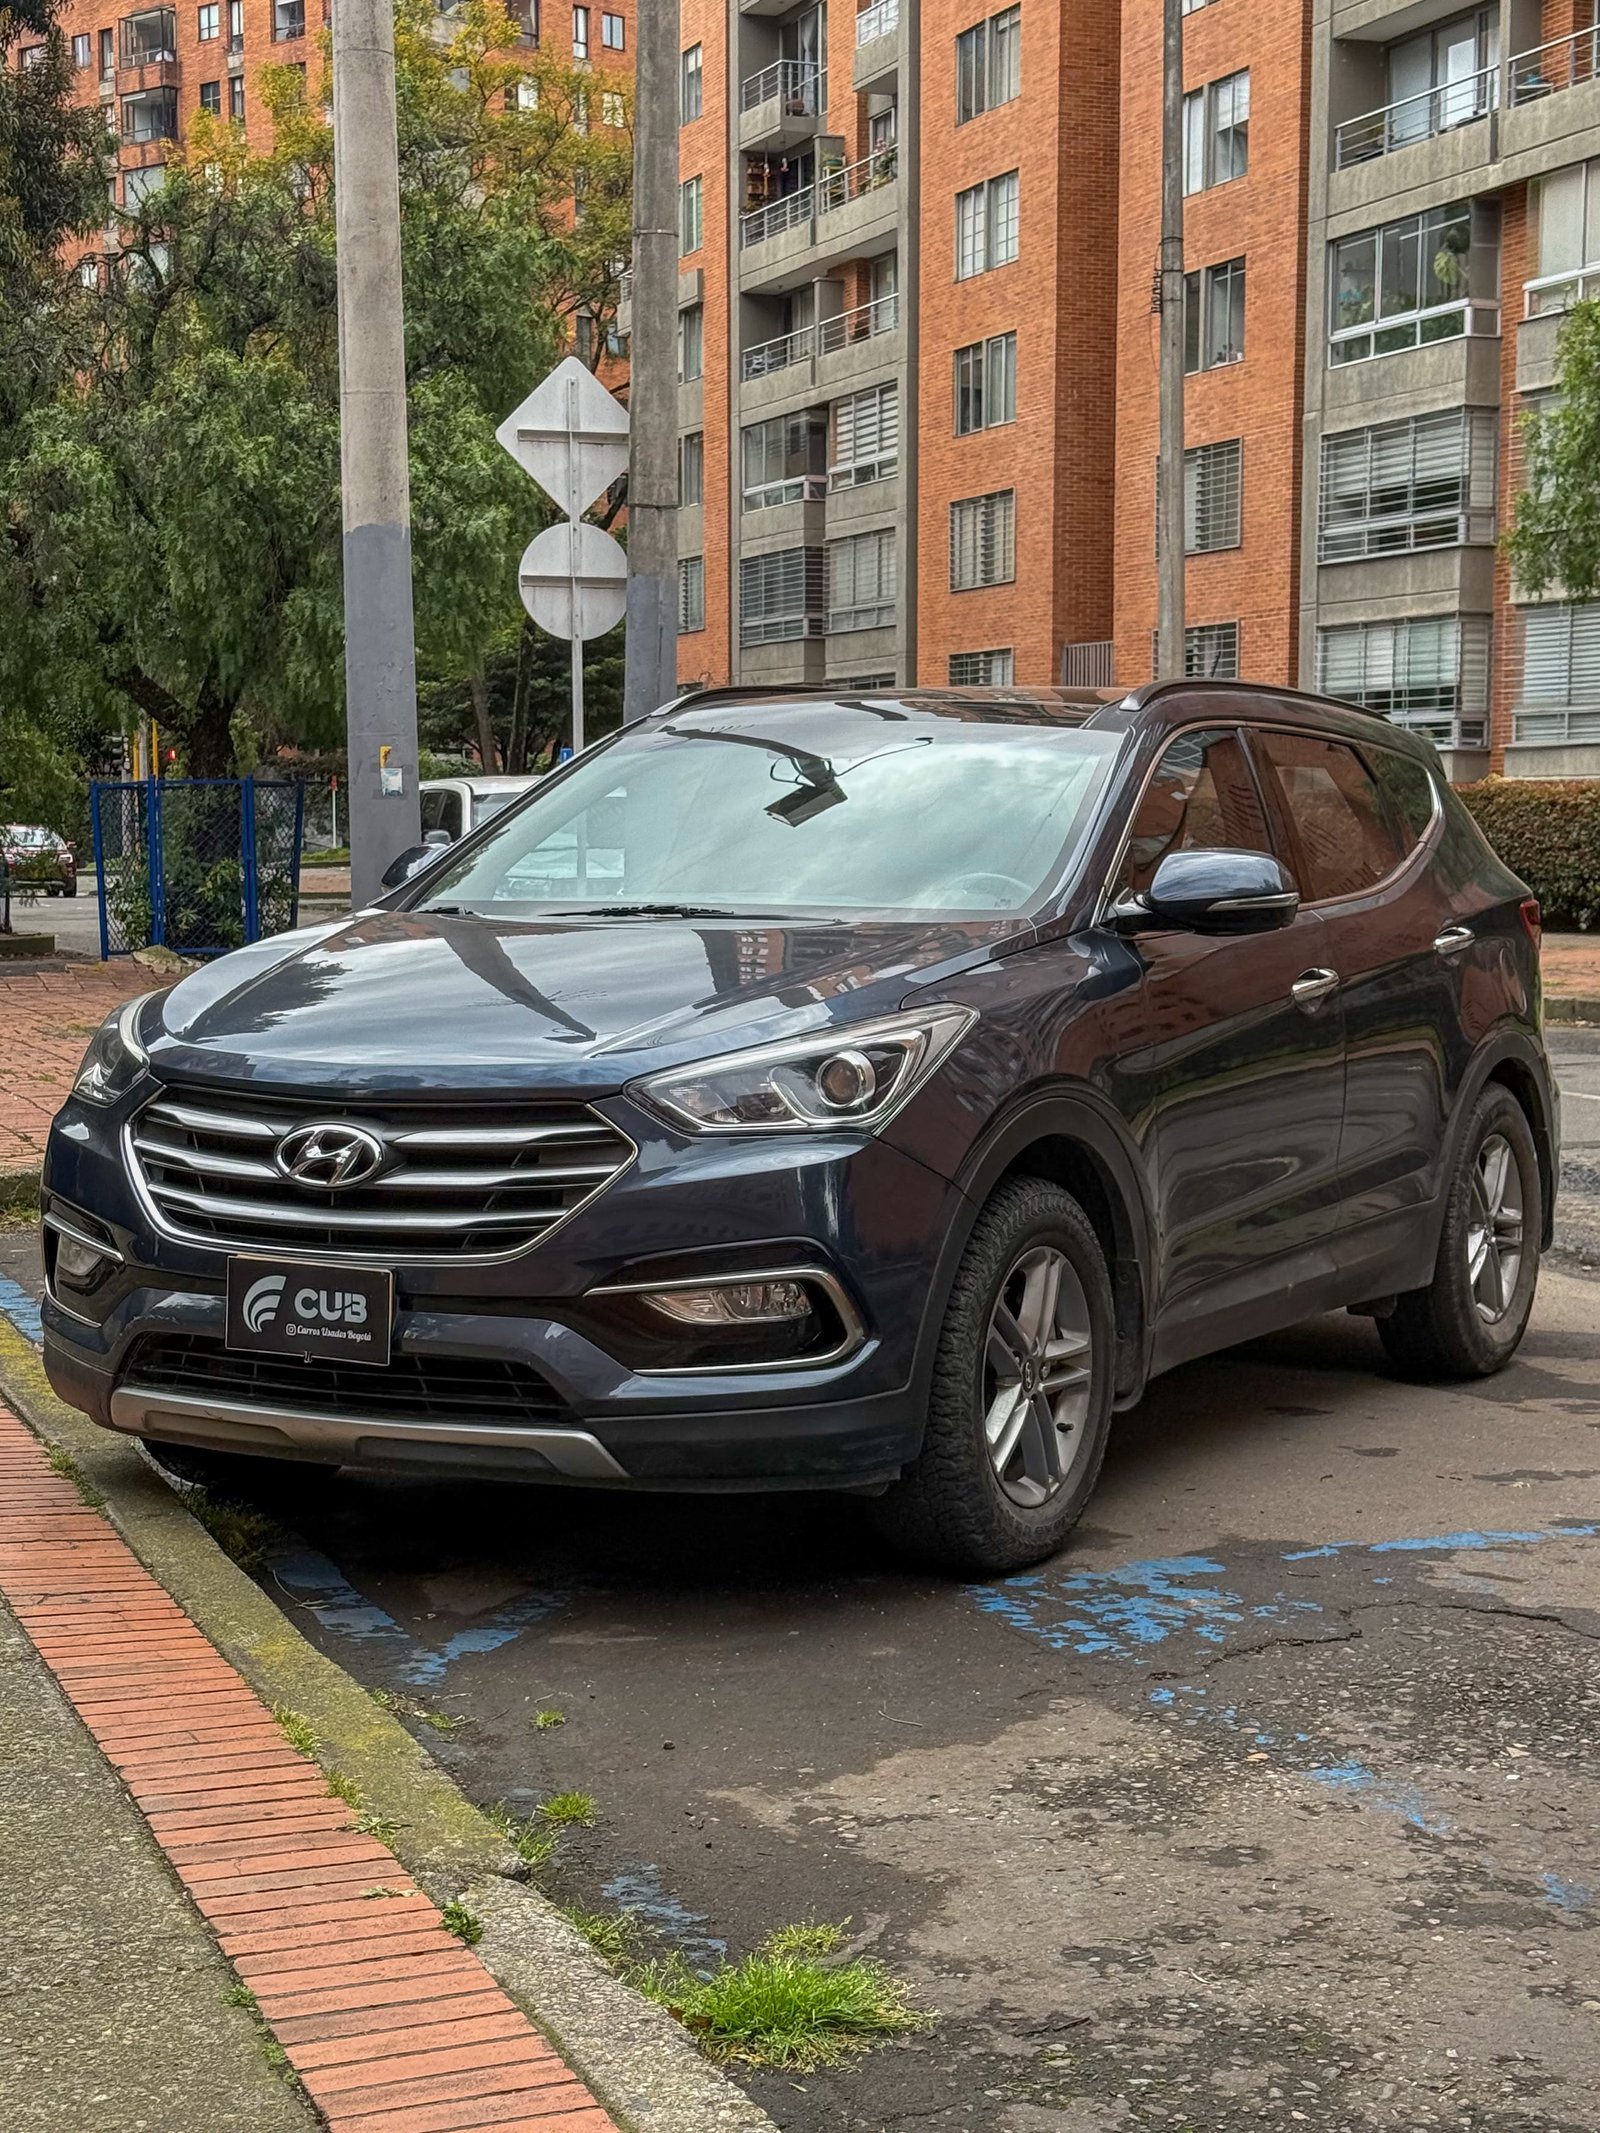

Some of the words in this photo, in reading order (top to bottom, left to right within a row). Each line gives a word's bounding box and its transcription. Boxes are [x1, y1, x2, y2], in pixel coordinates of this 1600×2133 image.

[294, 1288, 368, 1323] CUB
[297, 1325, 320, 1336] Carros
[321, 1326, 347, 1338] Usados
[347, 1330, 372, 1342] Bogotá
